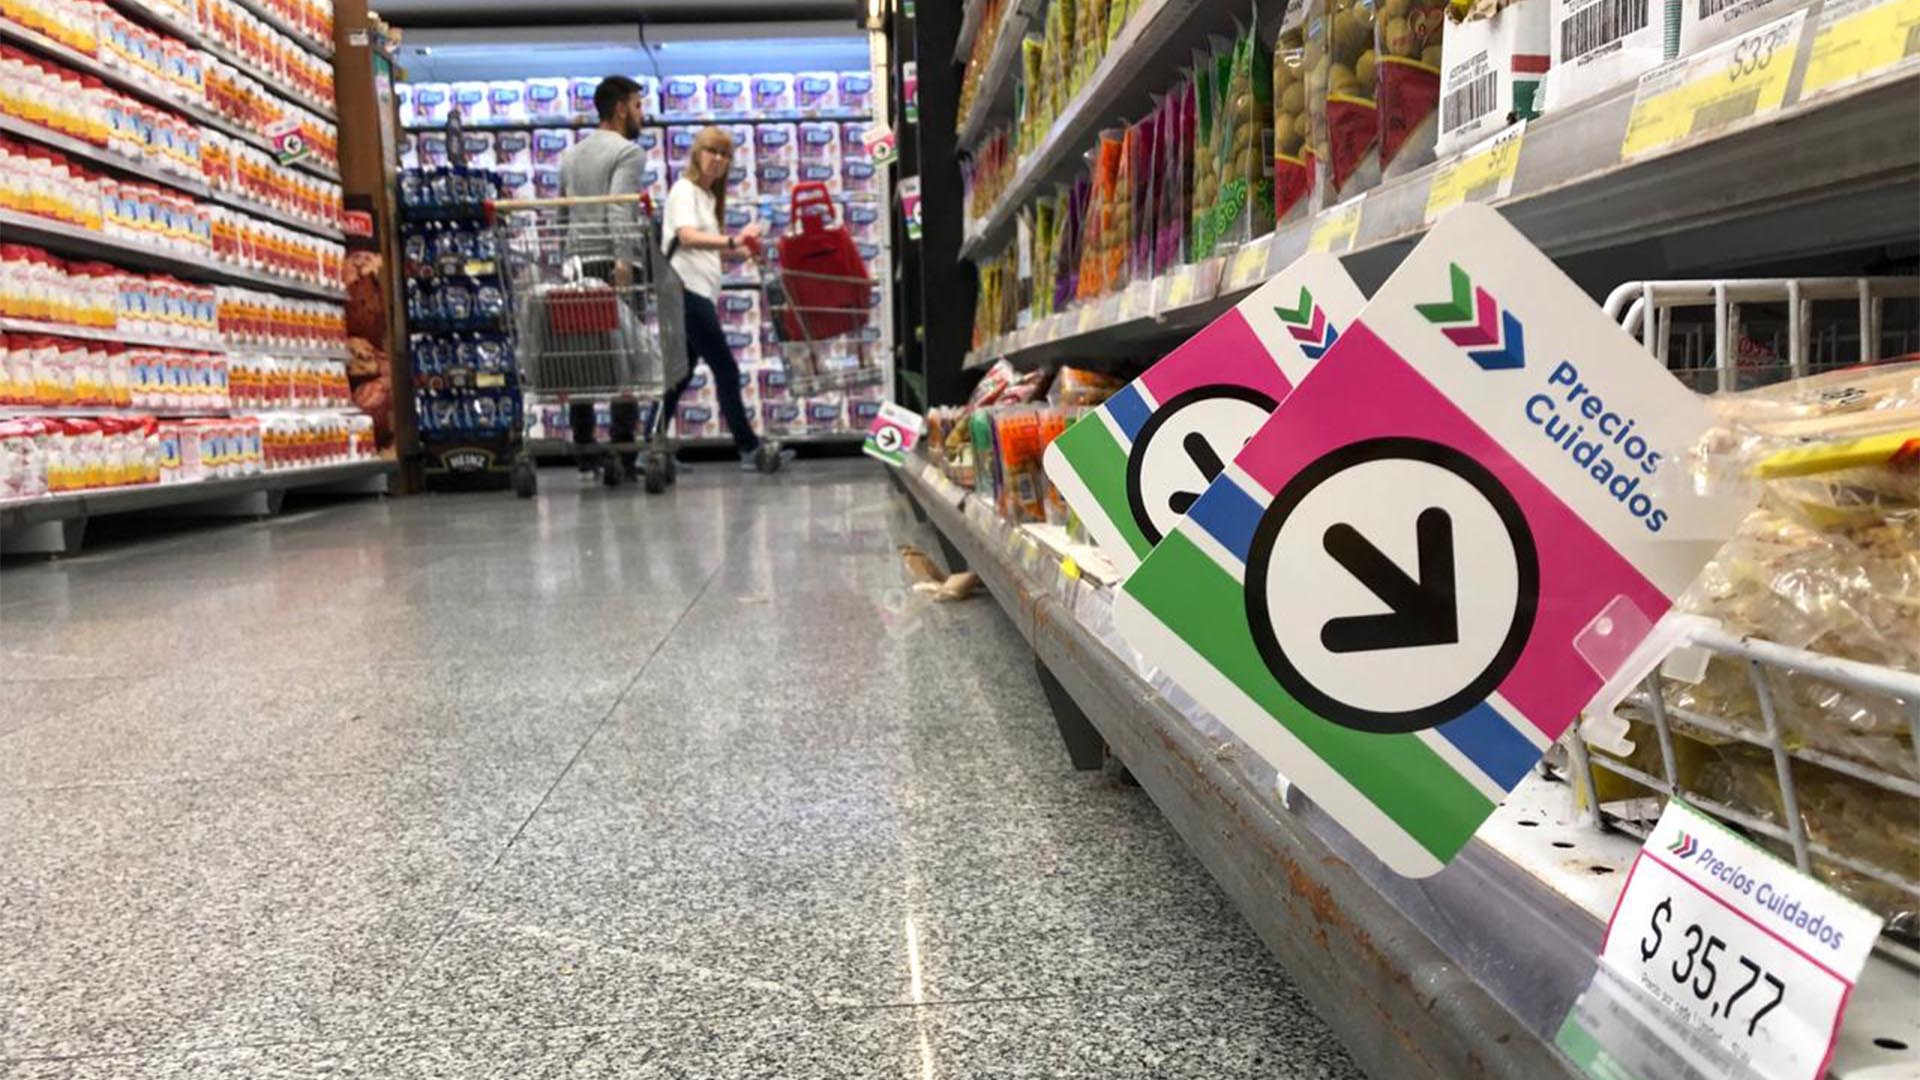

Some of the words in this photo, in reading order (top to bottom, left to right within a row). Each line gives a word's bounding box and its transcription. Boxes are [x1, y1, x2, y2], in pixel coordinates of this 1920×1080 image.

[1525, 394, 1669, 533] Cuidados
[1548, 360, 1664, 475] Precios
[1697, 848, 1755, 897] Precios
[1755, 883, 1845, 951] Cuidados
[1640, 896, 1673, 963] $
[1672, 924, 1786, 1037] 35,77
